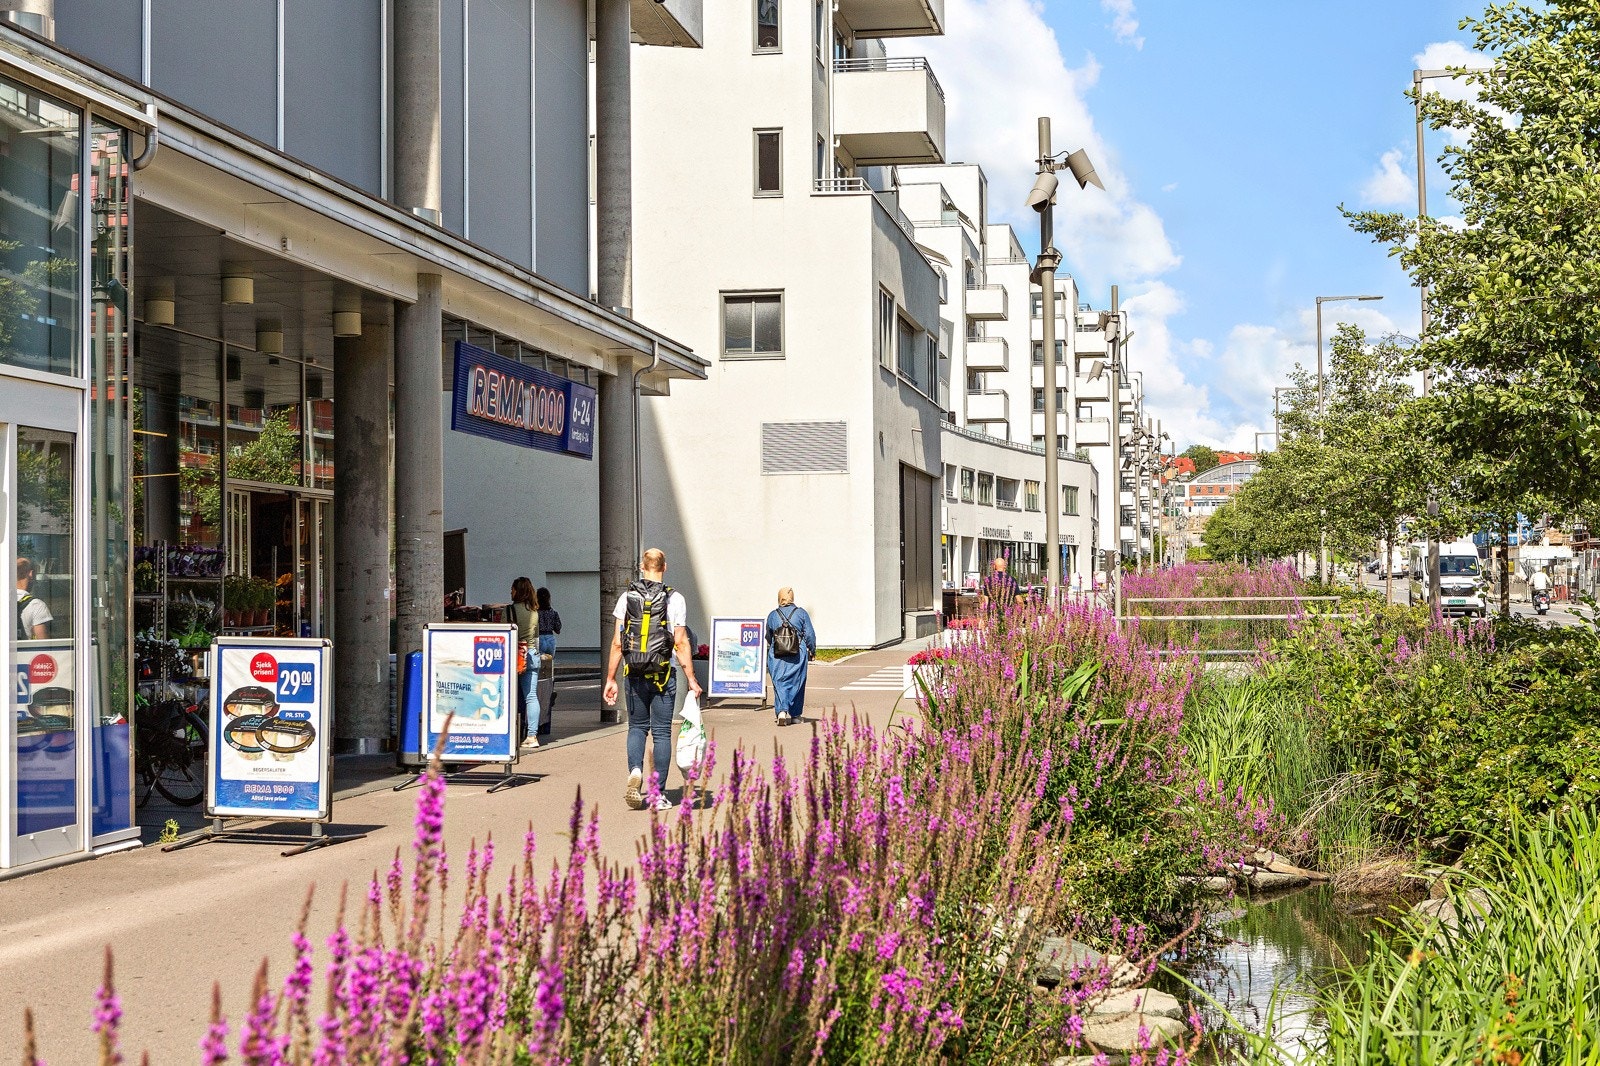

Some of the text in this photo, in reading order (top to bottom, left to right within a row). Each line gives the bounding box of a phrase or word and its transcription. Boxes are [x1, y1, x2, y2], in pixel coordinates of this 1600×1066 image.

[472, 364, 565, 435] REMA 1000
[573, 397, 590, 426] 6-24
[742, 630, 753, 643] 89
[255, 661, 272, 669] Sjekk
[477, 648, 493, 668] 89
[279, 670, 312, 696] 29 00
[244, 784, 295, 795] REMA 1000
